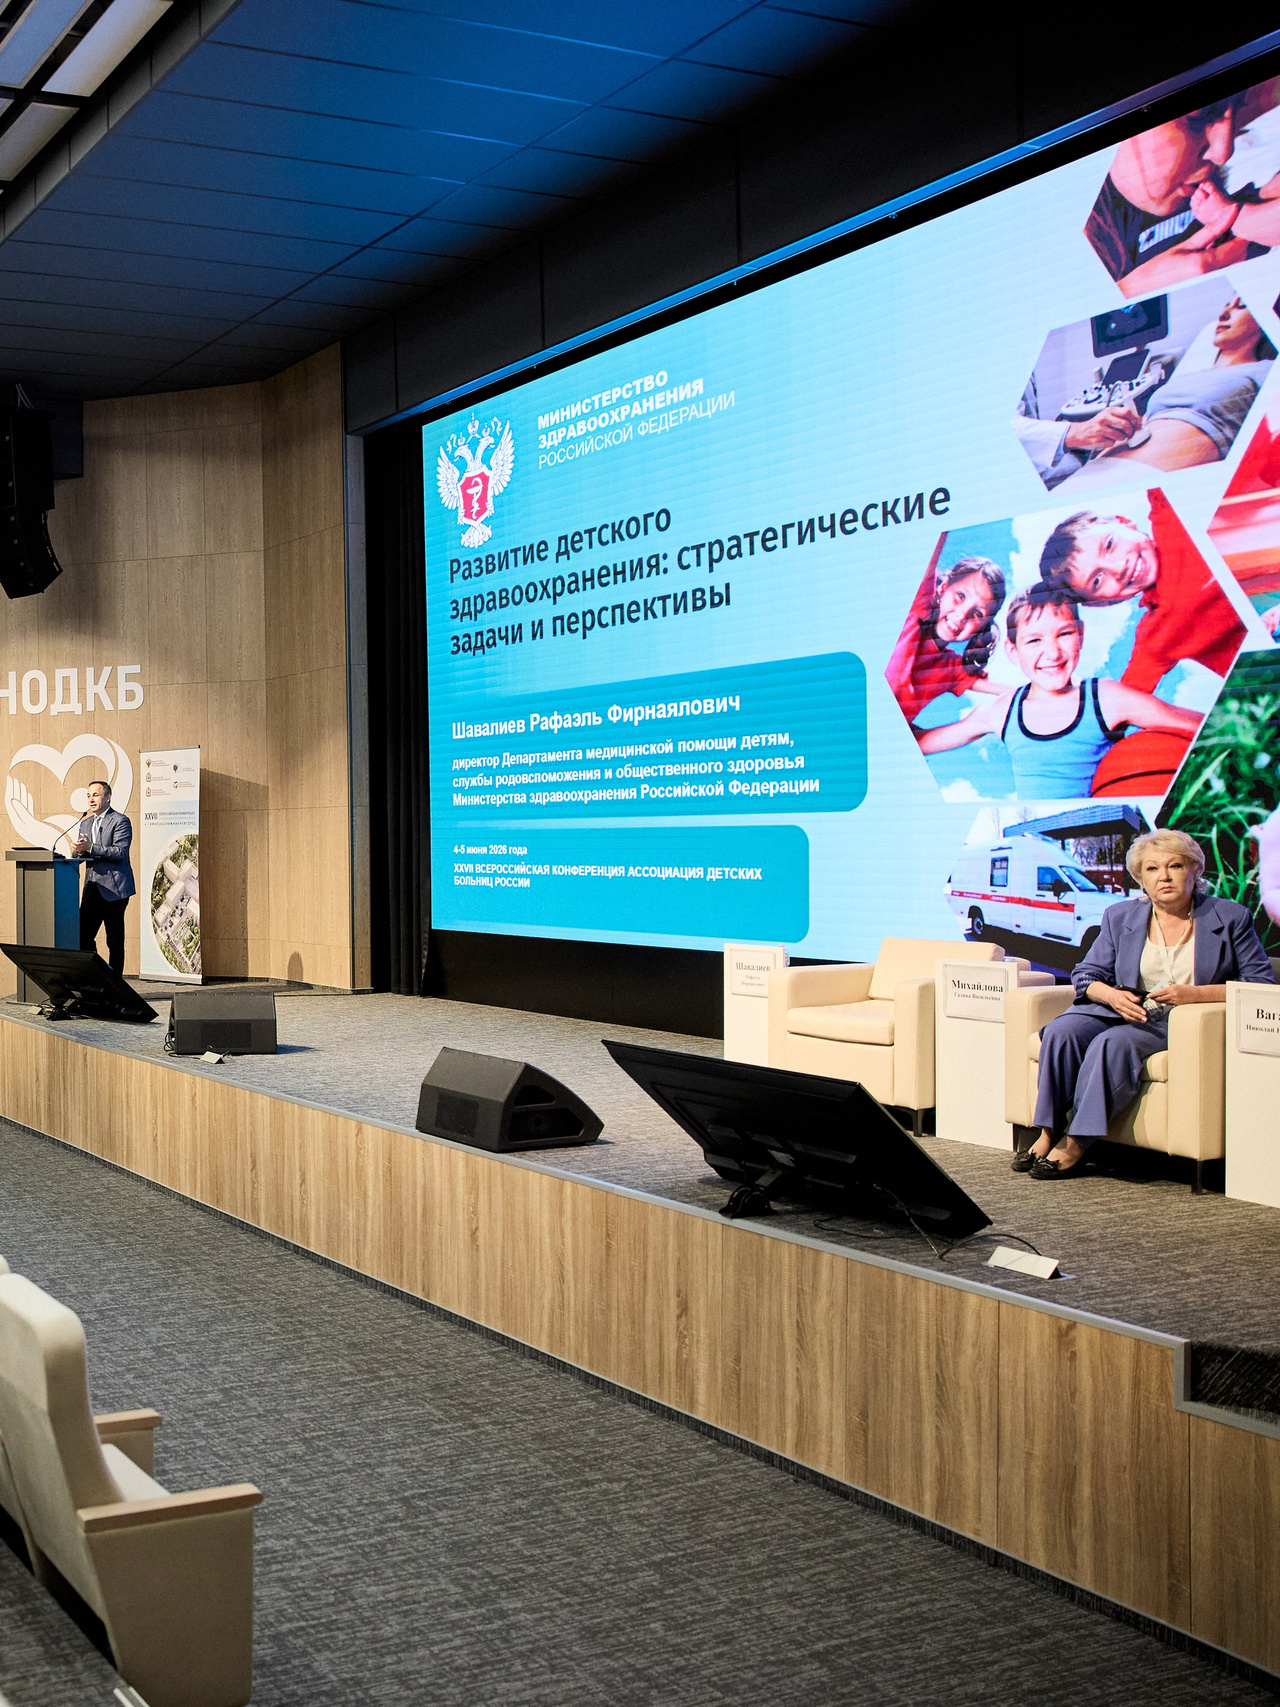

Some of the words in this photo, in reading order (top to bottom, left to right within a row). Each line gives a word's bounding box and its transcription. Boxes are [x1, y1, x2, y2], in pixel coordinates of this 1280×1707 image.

[537, 370, 669, 430] МИНИСТЕРСТВО
[538, 378, 704, 449] ЗДРАВООХРАНЕНИЯ
[538, 422, 634, 470] РОССИЙСКОЙ
[637, 390, 735, 437] ФЕДЕРАЦИИ
[449, 539, 549, 584] Развитие
[555, 508, 671, 563] детского
[449, 552, 669, 622] здравоохранения:
[677, 486, 951, 573] стратегические
[450, 622, 523, 657] задачи
[531, 618, 544, 641] и
[552, 582, 731, 640] перспективы
[452, 719, 526, 740] Шавалиев
[530, 710, 603, 734] Рафаэль
[607, 695, 741, 726] Фирнаялович
[452, 755, 500, 771] директор
[502, 749, 583, 768] Департамента
[586, 738, 674, 760] медицинской
[677, 736, 737, 753] помощи
[740, 731, 795, 750] детям,
[452, 772, 493, 790] службы
[495, 769, 601, 788] родовспоможения
[604, 768, 613, 779] и
[616, 760, 724, 780] общественного
[727, 755, 805, 774] здоровья
[453, 792, 527, 807] Министерства
[529, 787, 637, 805] здравоохранения
[640, 780, 725, 799] Российской
[728, 778, 820, 797] Федерации
[453, 844, 466, 854] 4-5
[466, 846, 488, 855] июня
[489, 844, 507, 855] 2026
[508, 845, 528, 856] года
[453, 863, 474, 873] XXVII
[475, 862, 550, 875] ВСЕРОССИЙСКАЯ
[552, 864, 626, 878] КОНФЕРЕНЦИЯ
[627, 865, 704, 880] АССОЦИАЦИЯ
[706, 867, 763, 881] ДЕТСКИХ
[453, 875, 493, 888] БОЛЬНИЦ
[494, 876, 531, 888] РОССИИ
[951, 979, 1004, 993] Михайлова
